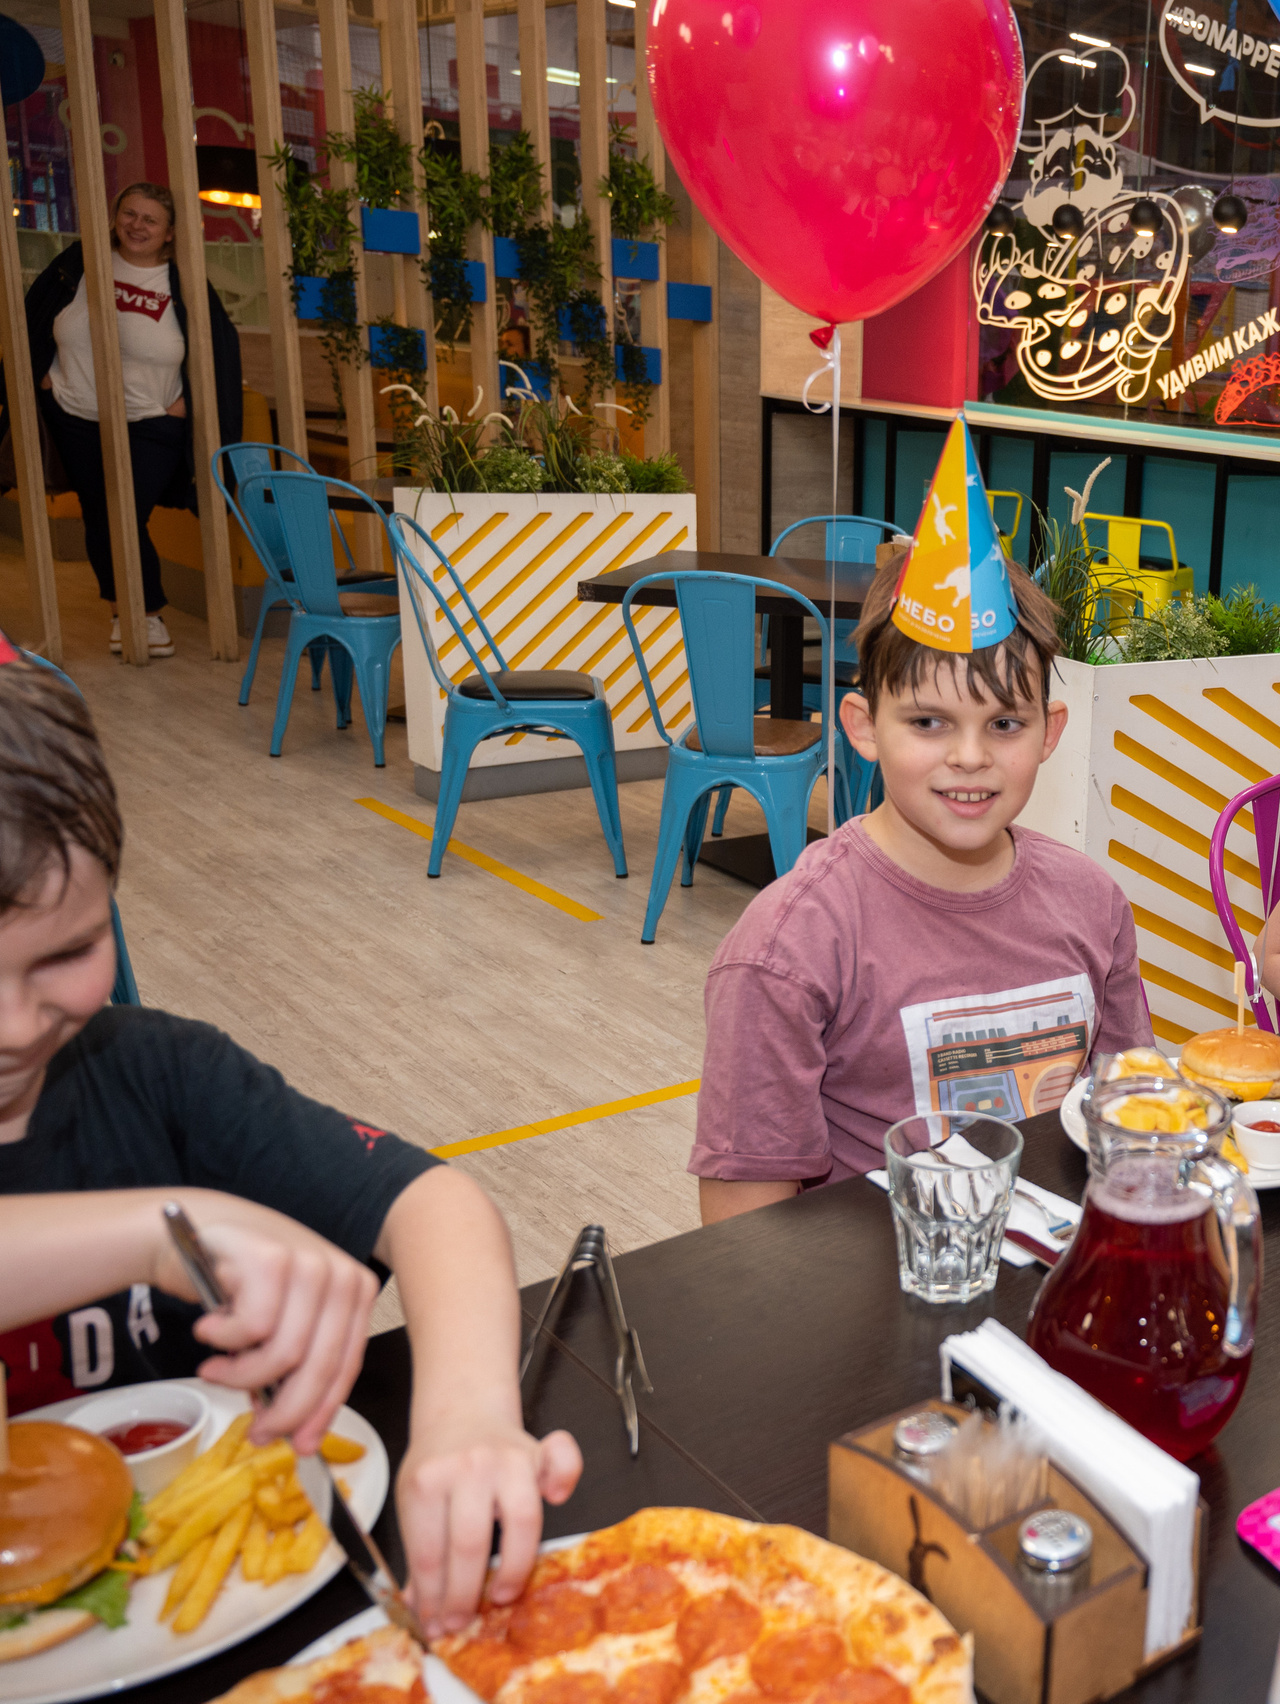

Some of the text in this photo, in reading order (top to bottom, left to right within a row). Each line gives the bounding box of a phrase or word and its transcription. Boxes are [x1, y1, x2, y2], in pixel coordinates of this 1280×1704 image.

[114, 287, 160, 312] evi's
[1156, 336, 1235, 400] УДИВИМ
[900, 593, 955, 633] НЕБО
